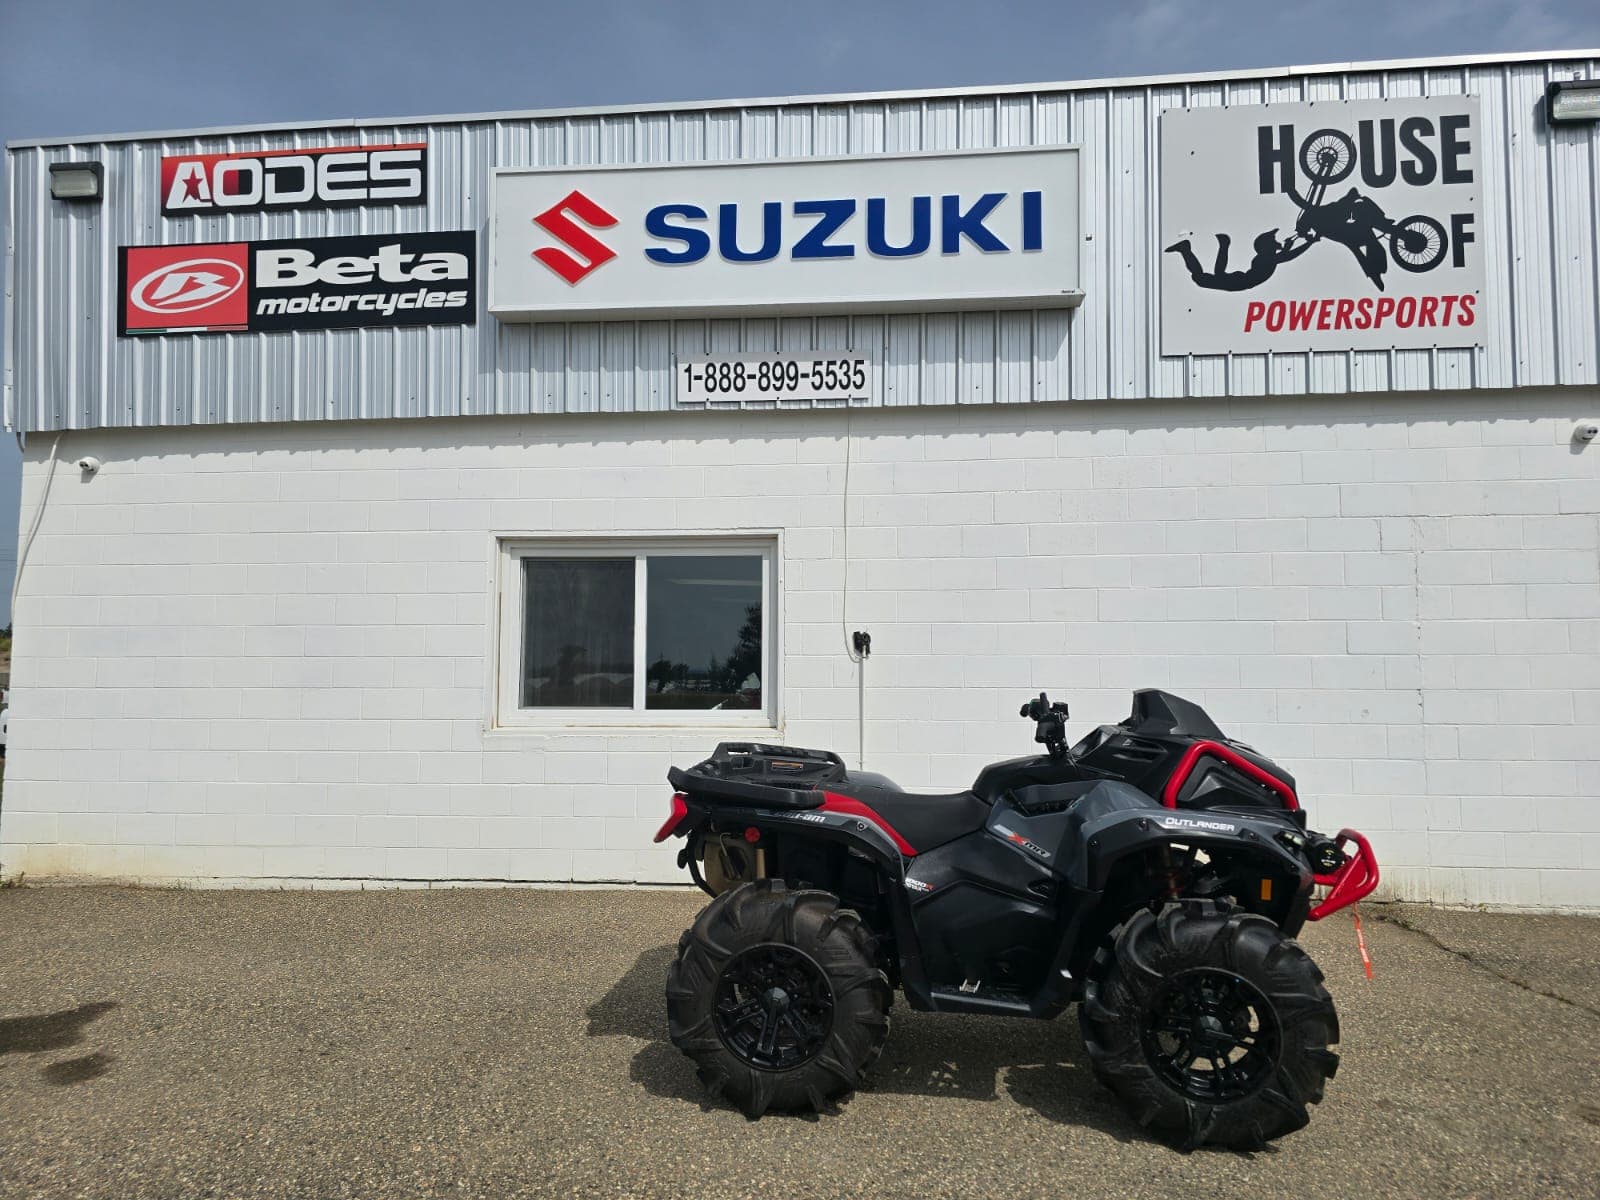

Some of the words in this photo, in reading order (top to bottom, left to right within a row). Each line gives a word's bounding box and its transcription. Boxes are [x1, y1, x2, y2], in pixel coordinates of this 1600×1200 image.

[1257, 114, 1474, 194] HOUSE
[166, 150, 422, 209] AODES
[644, 190, 1043, 266] SUZUKI
[1389, 213, 1475, 273] OF
[255, 244, 469, 288] Beta
[255, 288, 468, 316] motorcycles
[1243, 294, 1476, 333] POWERSPORTS
[683, 359, 866, 393] 1-888-899-5535
[1165, 817, 1235, 832] OUTLANDER
